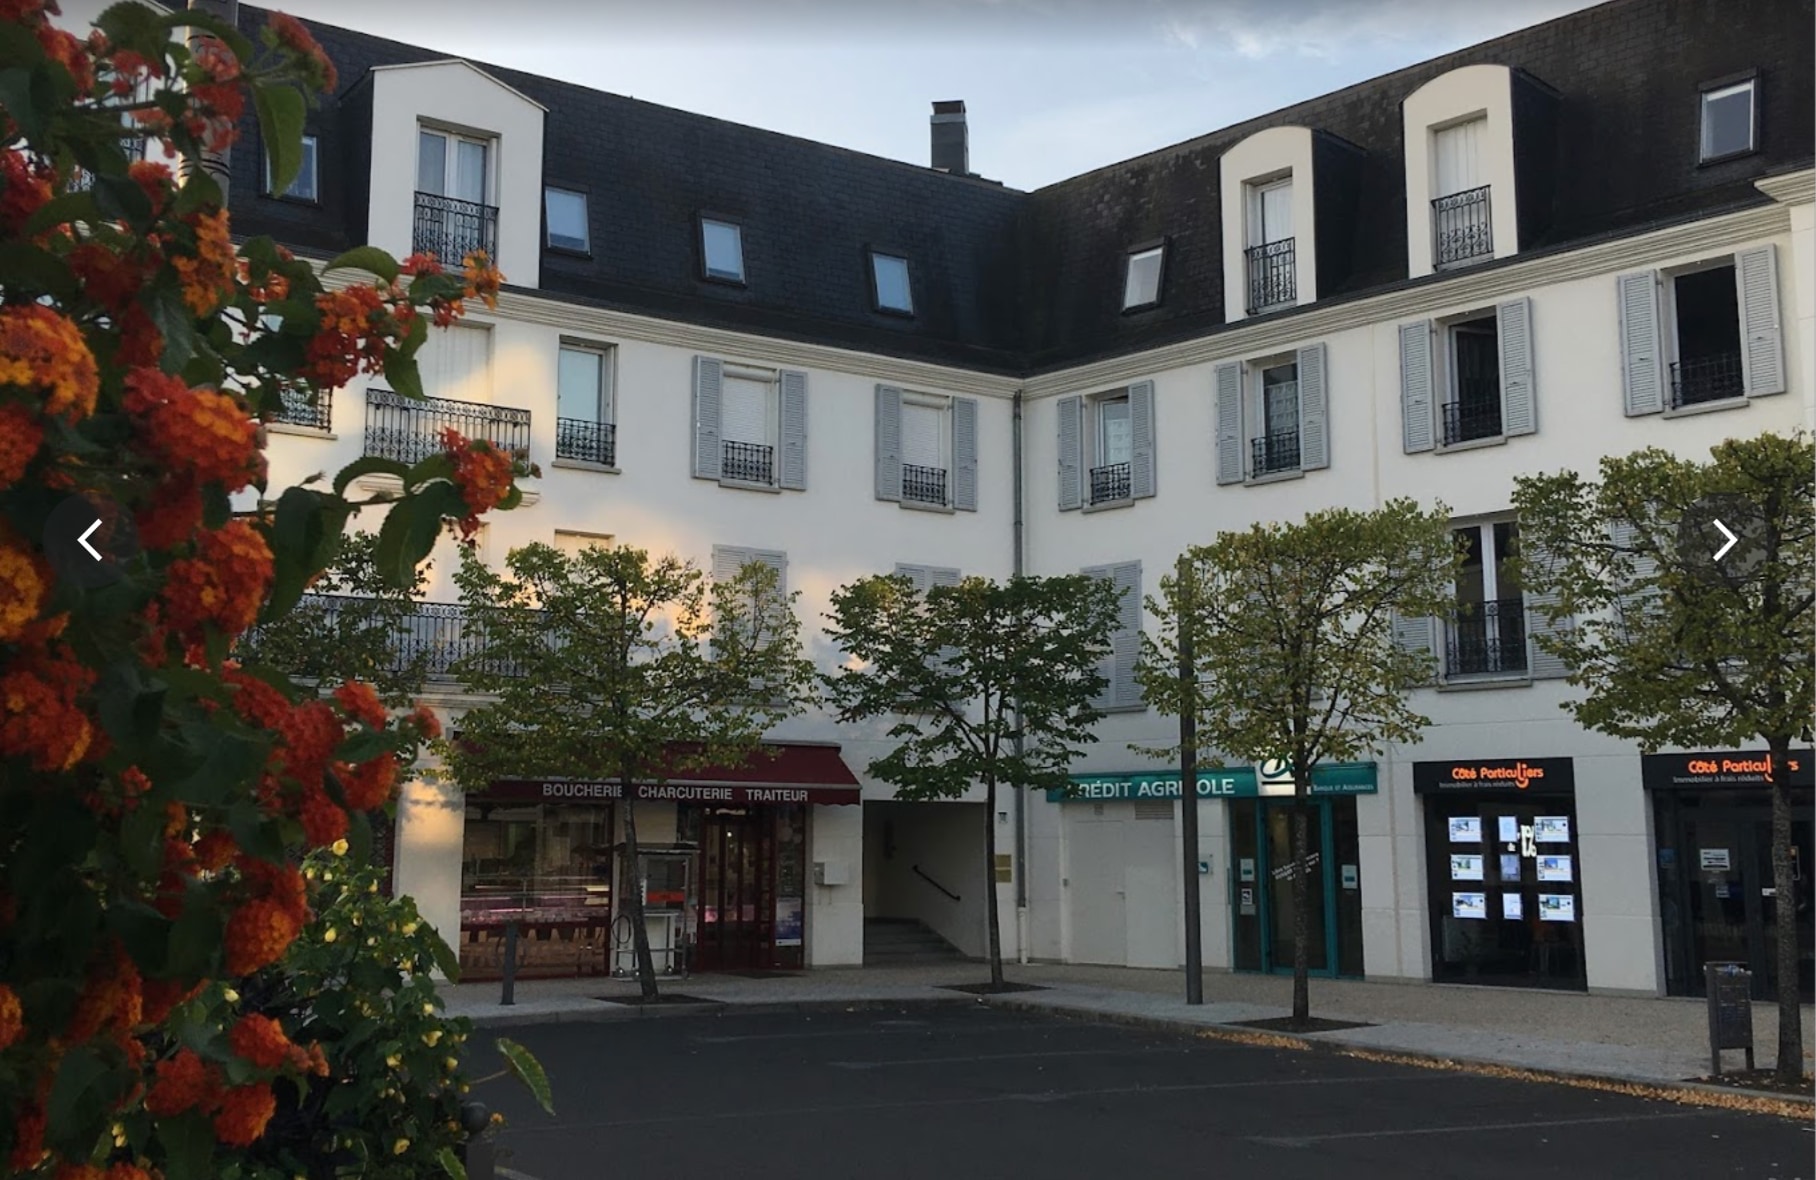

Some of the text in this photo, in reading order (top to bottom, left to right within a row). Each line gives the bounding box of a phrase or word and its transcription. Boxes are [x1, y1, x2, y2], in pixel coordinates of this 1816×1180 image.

[1452, 762, 1543, 788] Côté Particuliers
[1687, 760, 1719, 774] Côté
[542, 783, 809, 802] BOUCHERIE CHARCUTERIE TRAITEUR
[1137, 778, 1236, 797] AGRIOLE
